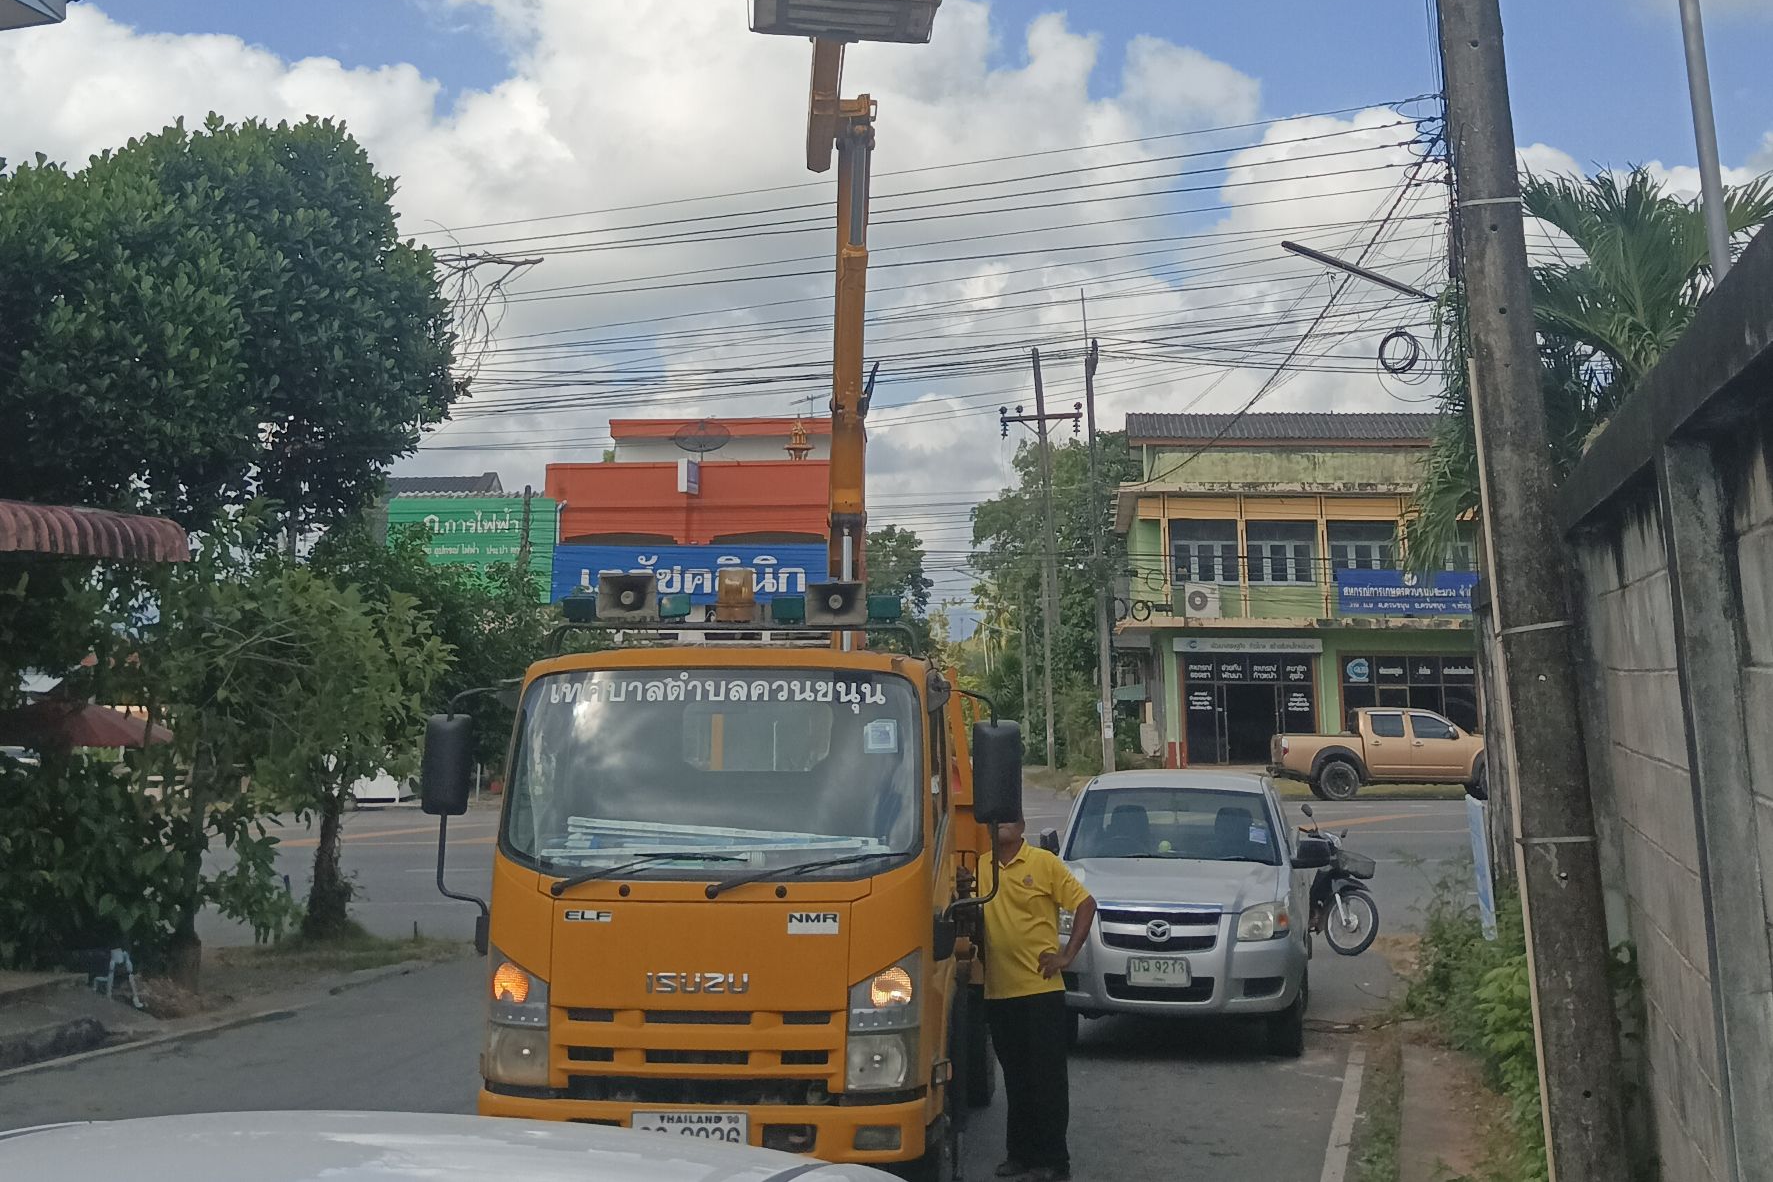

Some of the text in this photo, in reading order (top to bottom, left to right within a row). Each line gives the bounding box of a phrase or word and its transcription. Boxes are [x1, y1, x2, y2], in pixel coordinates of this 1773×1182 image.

[549, 671, 887, 714] เทศบาลตำบลควนขนุน
[564, 910, 612, 921] ELF
[788, 913, 838, 924] NMR
[646, 972, 749, 994] ISUZU
[659, 1115, 723, 1124] THAILAND
